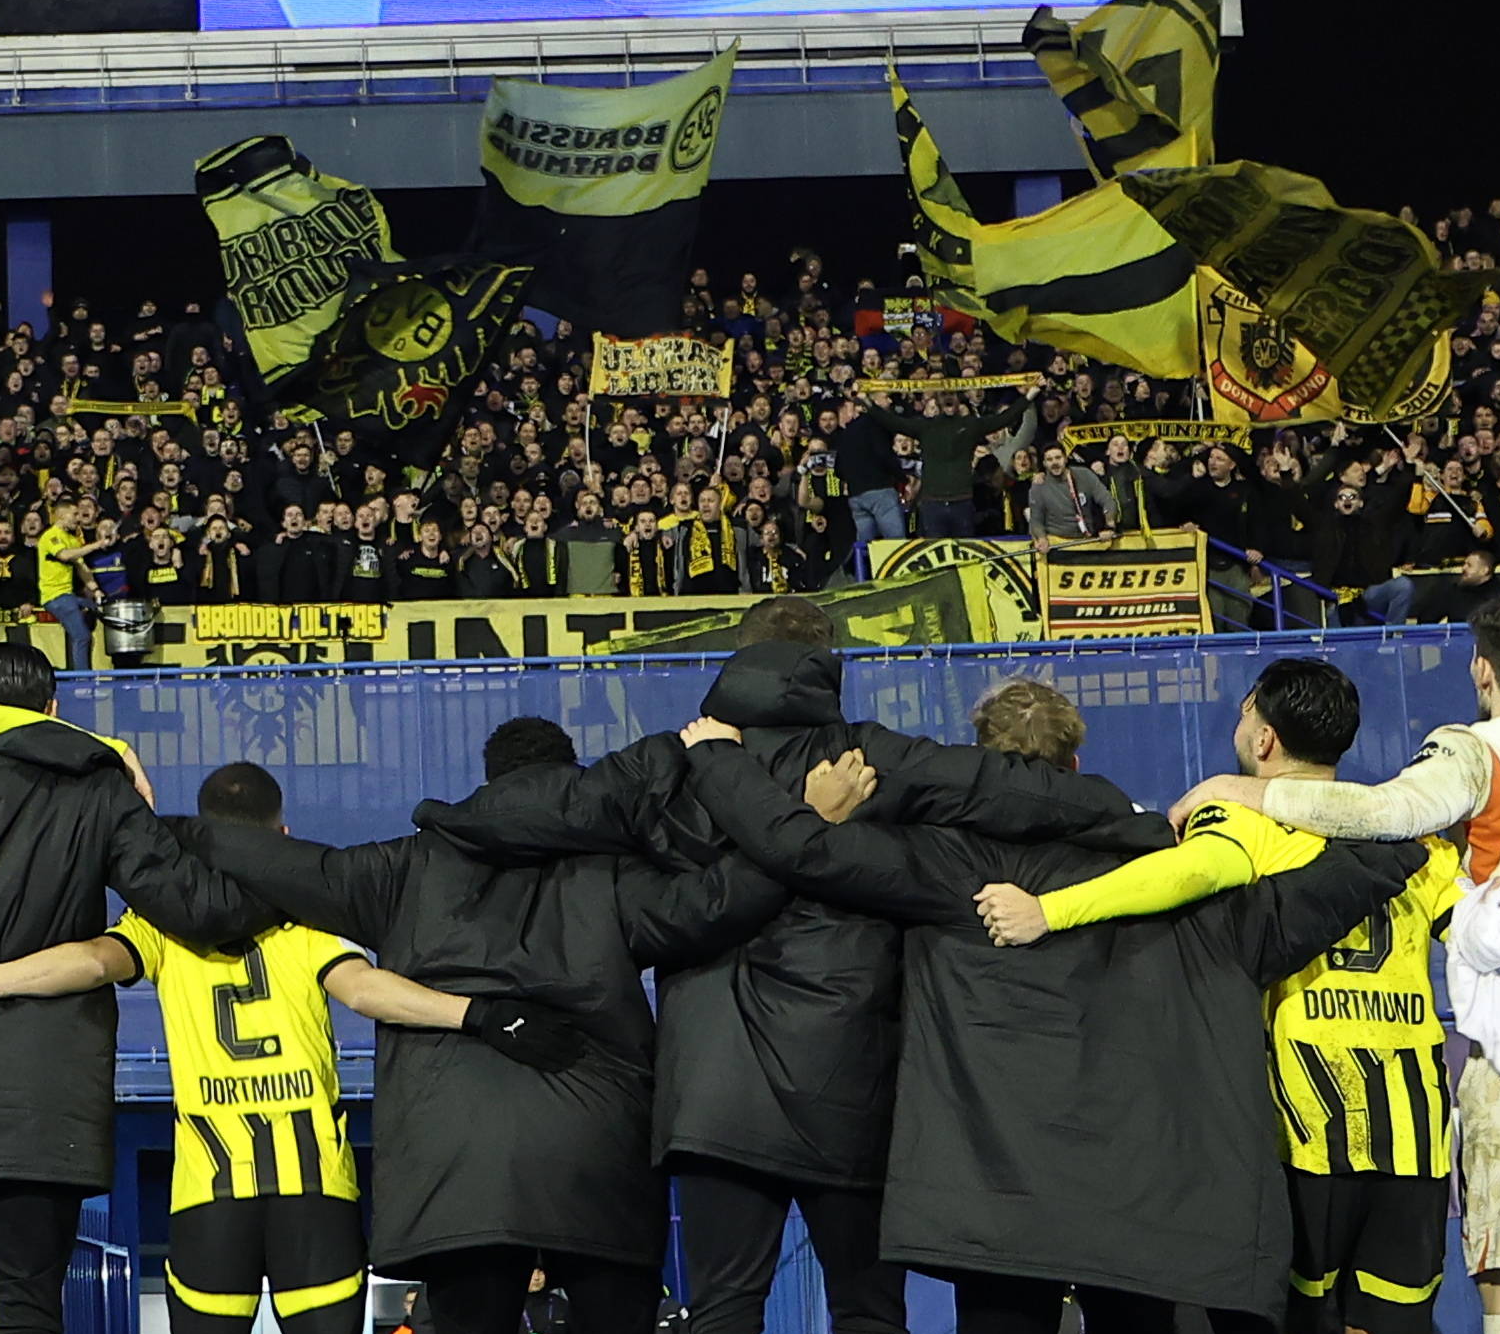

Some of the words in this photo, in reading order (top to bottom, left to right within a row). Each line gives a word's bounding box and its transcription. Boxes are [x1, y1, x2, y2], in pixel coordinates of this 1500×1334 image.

[1058, 567, 1187, 591] SCHEISS
[212, 943, 283, 1062] 2
[1303, 987, 1425, 1026] DORTMUND
[199, 1068, 315, 1107] DORTMUND
